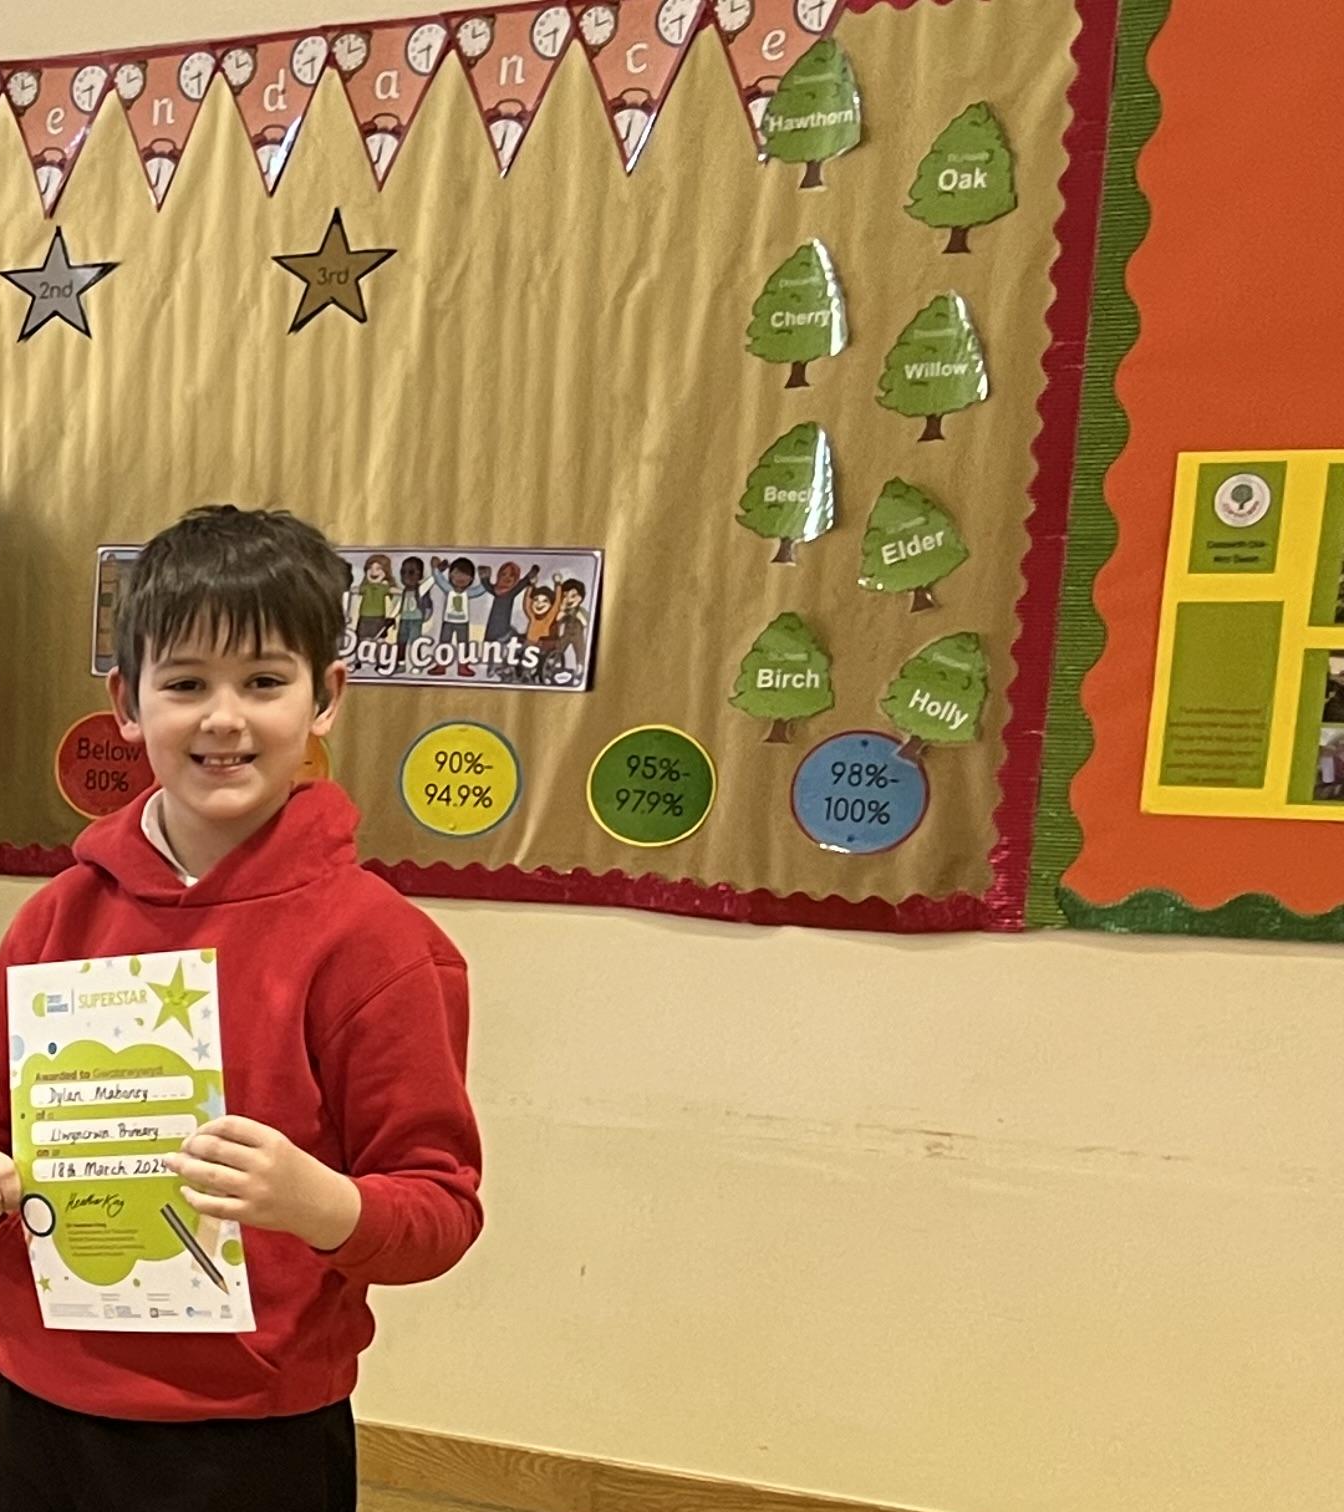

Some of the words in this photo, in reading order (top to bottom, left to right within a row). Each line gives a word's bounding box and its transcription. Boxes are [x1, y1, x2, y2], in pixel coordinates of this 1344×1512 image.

[769, 109, 853, 132] Hawthorn
[933, 167, 988, 192] Oak
[317, 263, 349, 286] 3rd
[39, 279, 74, 301] 2nd
[770, 311, 831, 328] Cherry
[904, 362, 968, 380] Willow
[881, 531, 944, 565] Elder
[412, 636, 540, 668] Counts
[756, 668, 820, 688] Birch
[908, 689, 968, 730] Holly
[77, 737, 142, 763] Below
[434, 749, 494, 776] 90%-
[626, 755, 690, 781] 95%-
[84, 769, 129, 793] 80%
[831, 761, 899, 789] 98%-
[424, 782, 494, 809] 94.9%
[824, 797, 891, 825] 100%
[79, 989, 147, 1009] SUPERSTAR
[48, 1087, 84, 1107] Dylan
[84, 1161, 128, 1177] March
